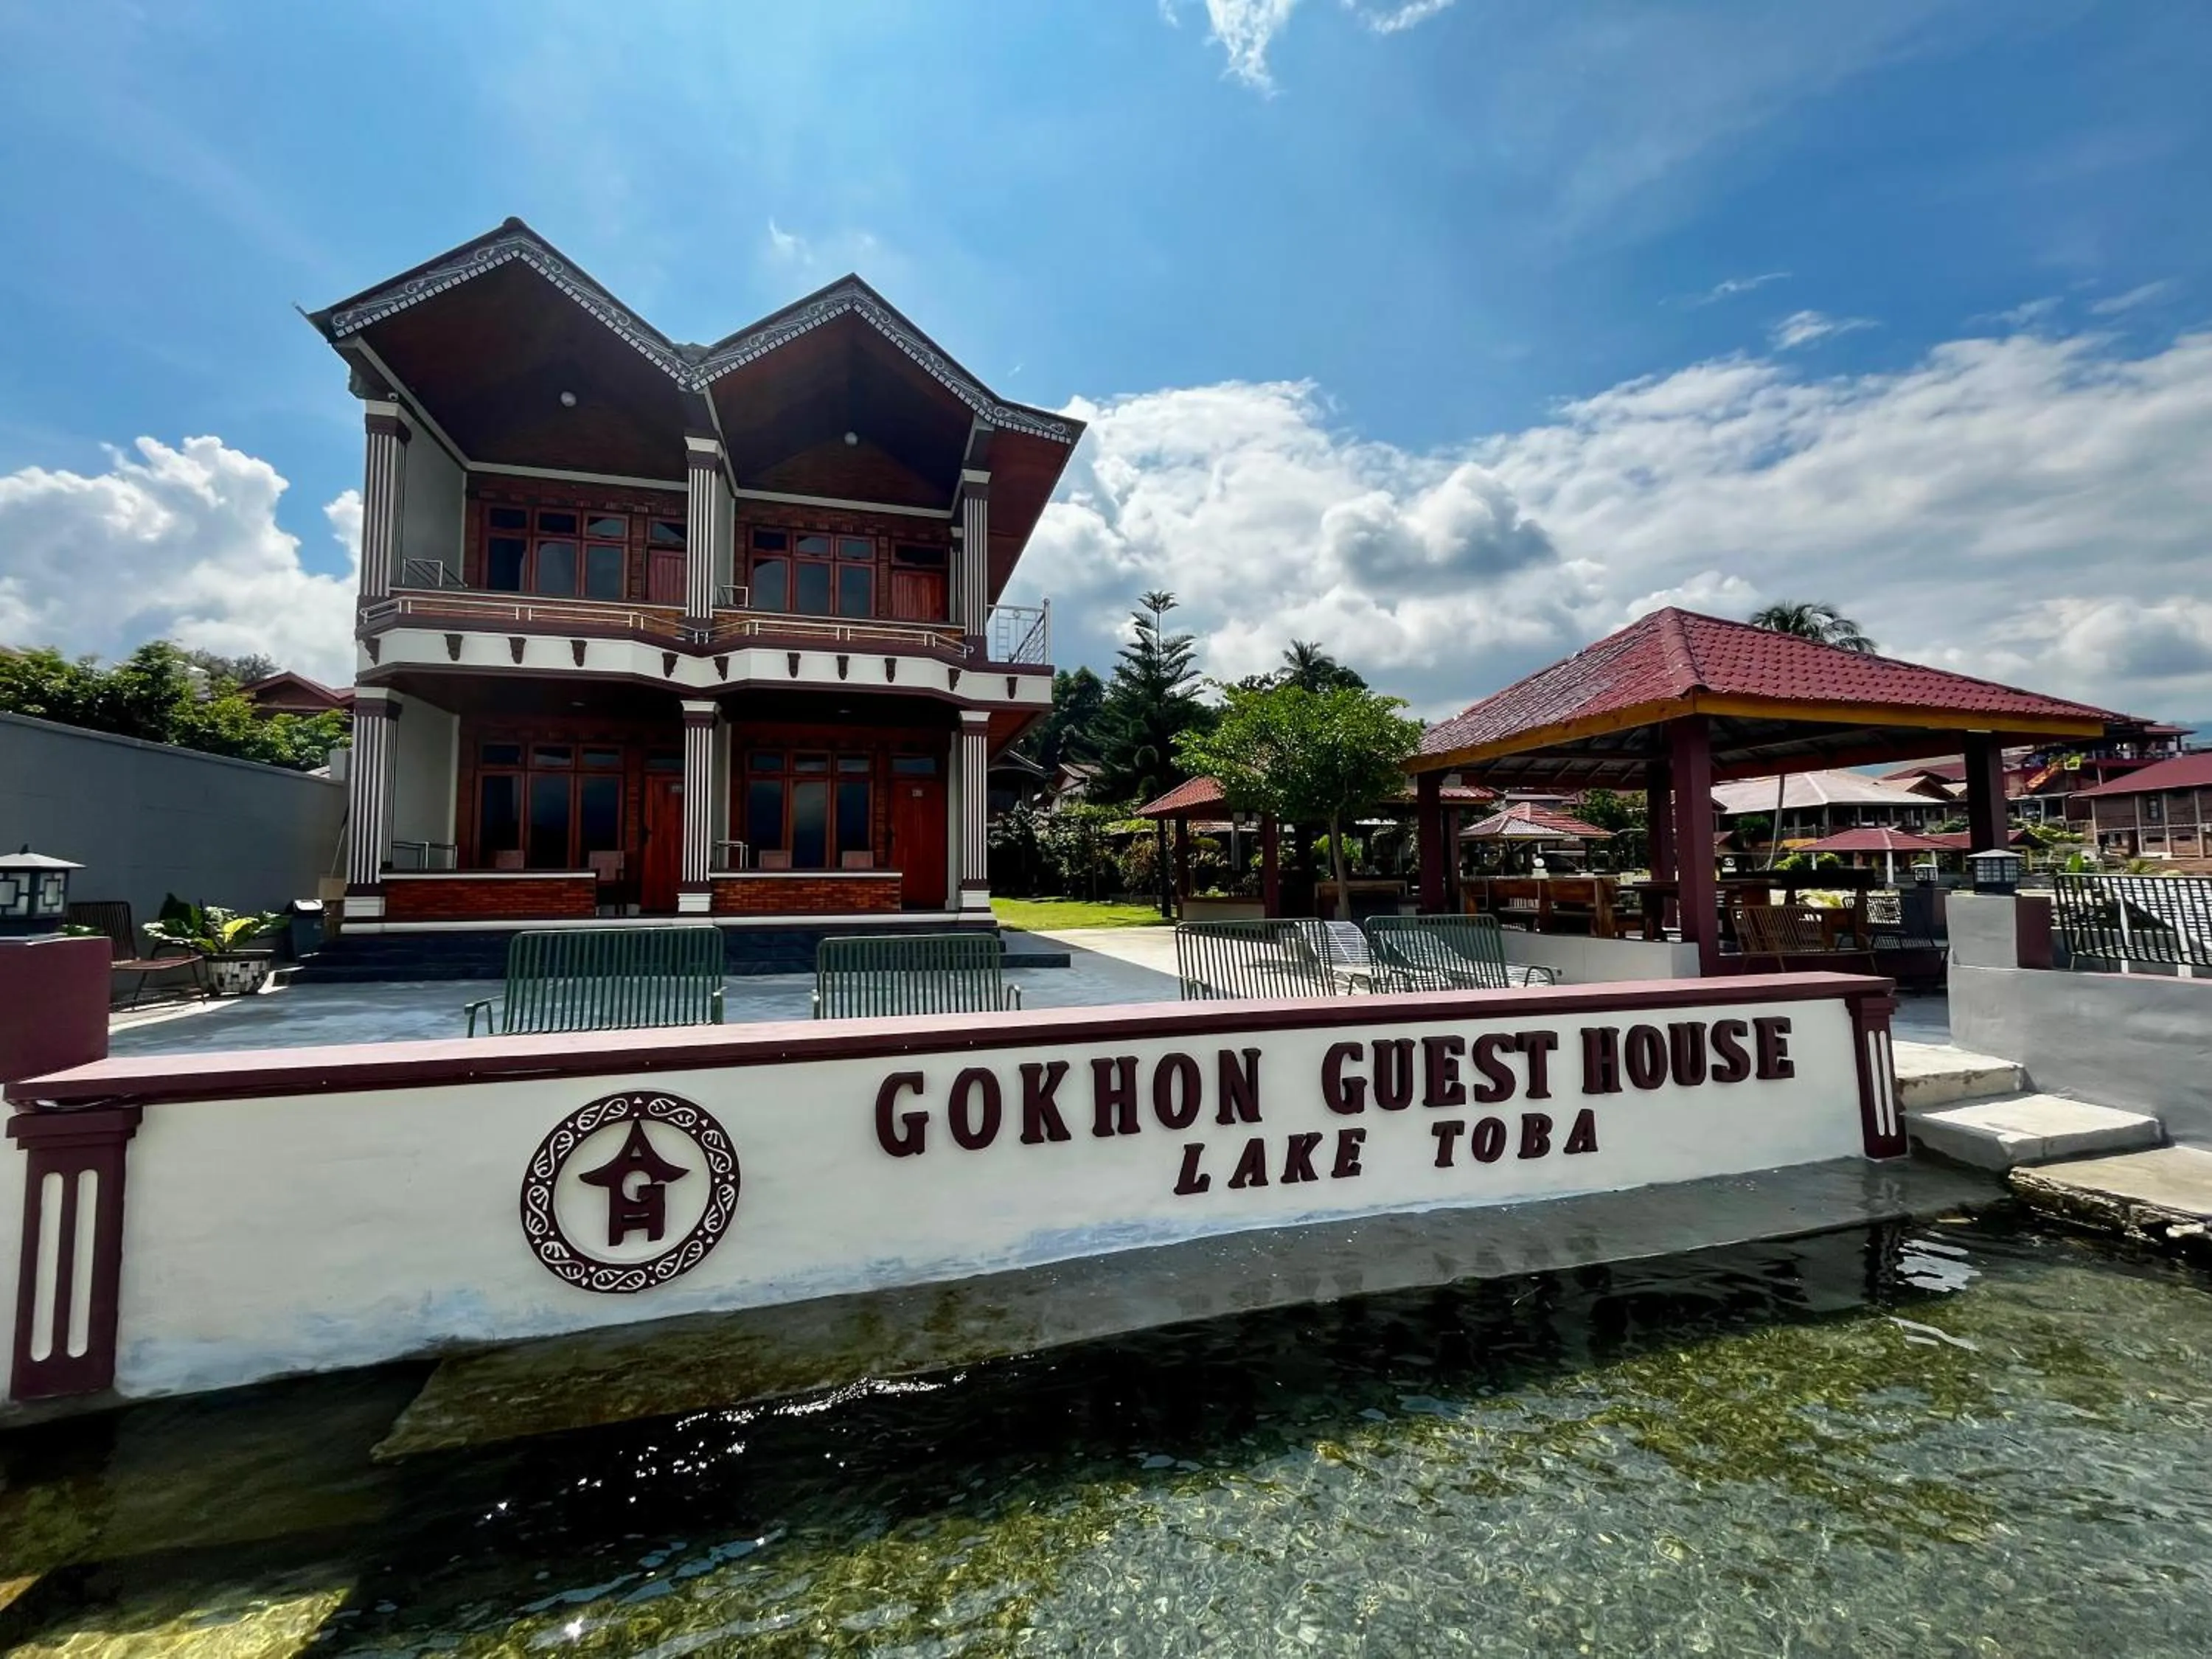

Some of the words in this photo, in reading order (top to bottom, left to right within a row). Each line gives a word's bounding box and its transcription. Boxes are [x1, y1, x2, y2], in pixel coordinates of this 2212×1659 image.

[874, 1048, 1263, 1158] GOKHON
[1321, 1030, 1559, 1116] GUEST
[1580, 1016, 1795, 1095] HOUSE
[1173, 1127, 1367, 1196] LAKE
[1431, 1108, 1599, 1169] TOBA
